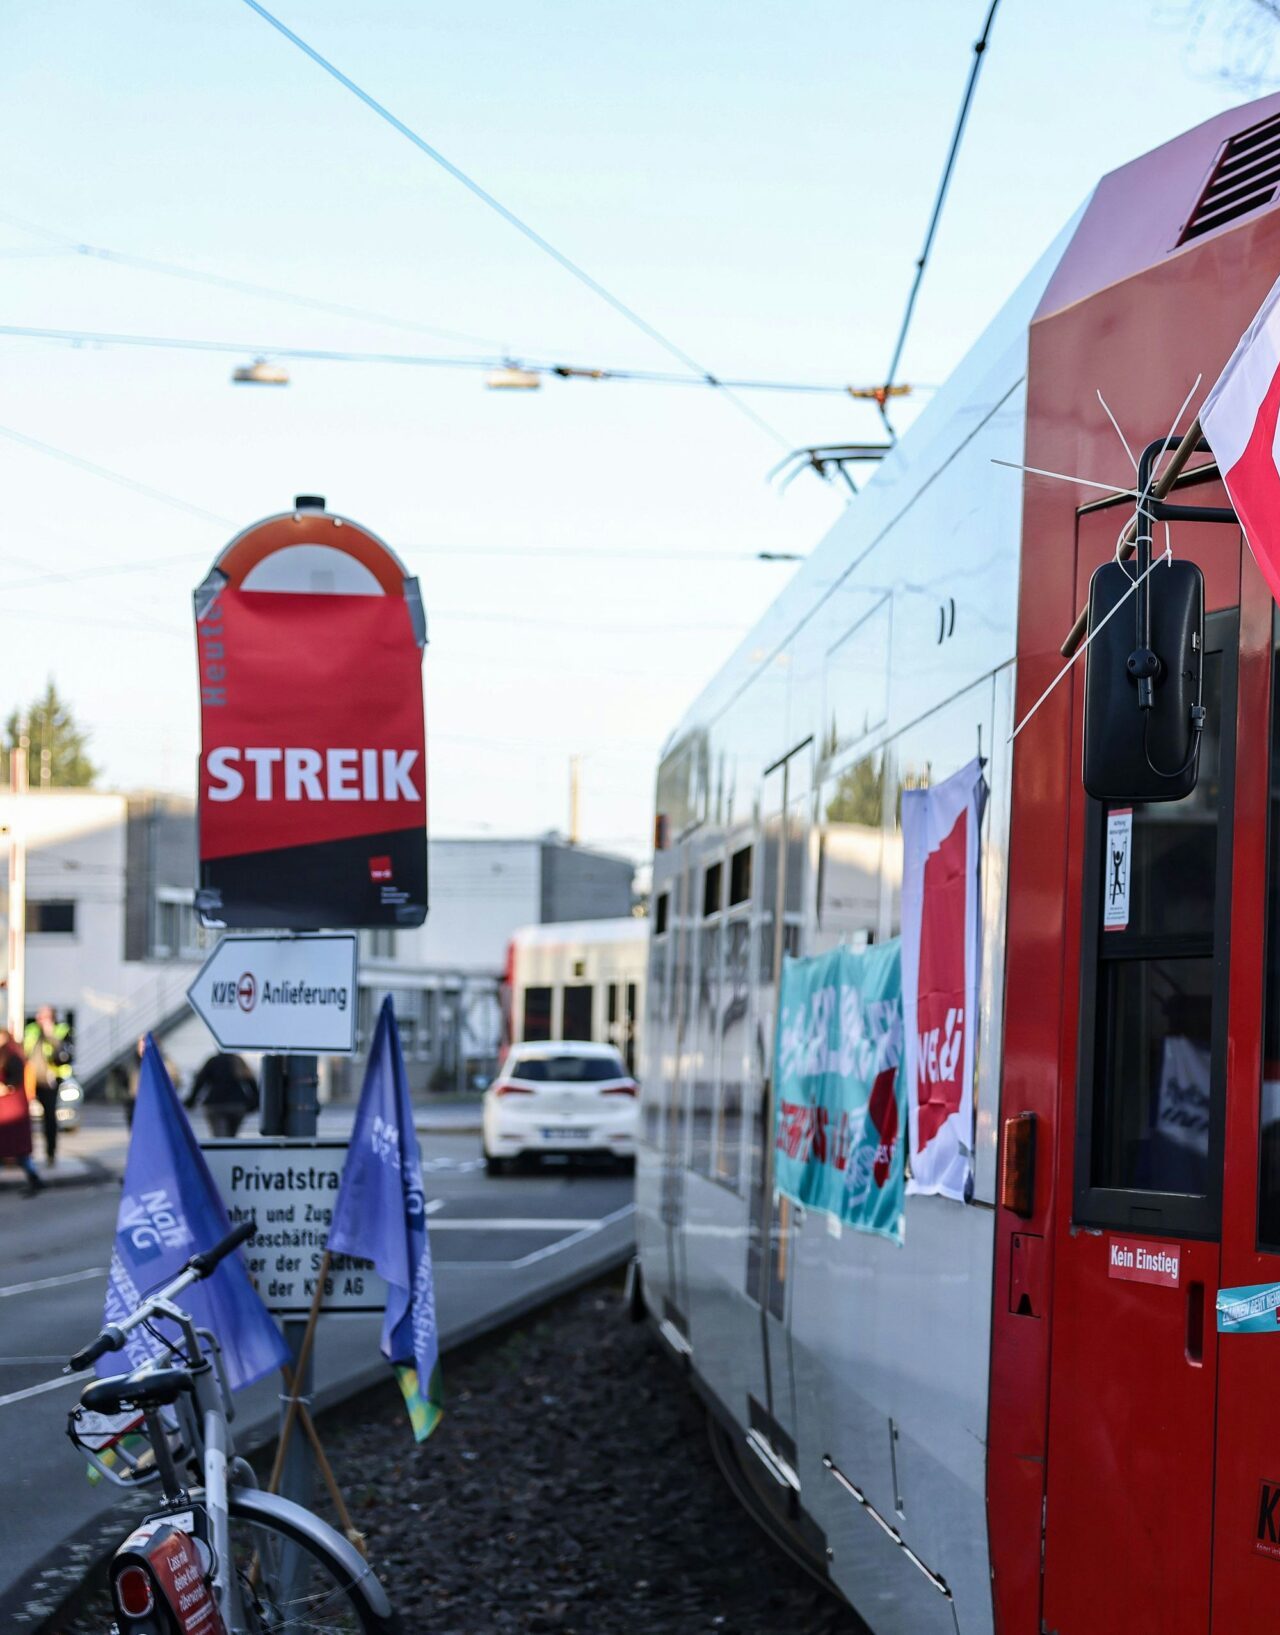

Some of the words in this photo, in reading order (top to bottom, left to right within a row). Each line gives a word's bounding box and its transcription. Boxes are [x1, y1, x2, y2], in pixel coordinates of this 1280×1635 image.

[206, 746, 421, 801] STREIK
[211, 981, 237, 1003] KVB
[261, 980, 347, 1011] Anlieferung
[231, 1165, 339, 1191] Privatstra
[266, 1205, 295, 1223] und
[304, 1204, 332, 1226] Zug
[245, 1257, 266, 1272] er
[275, 1254, 301, 1272] der
[1111, 1244, 1134, 1267] Kein
[1136, 1247, 1178, 1279] Einstieg
[268, 1278, 294, 1297] der
[343, 1276, 365, 1296] AG
